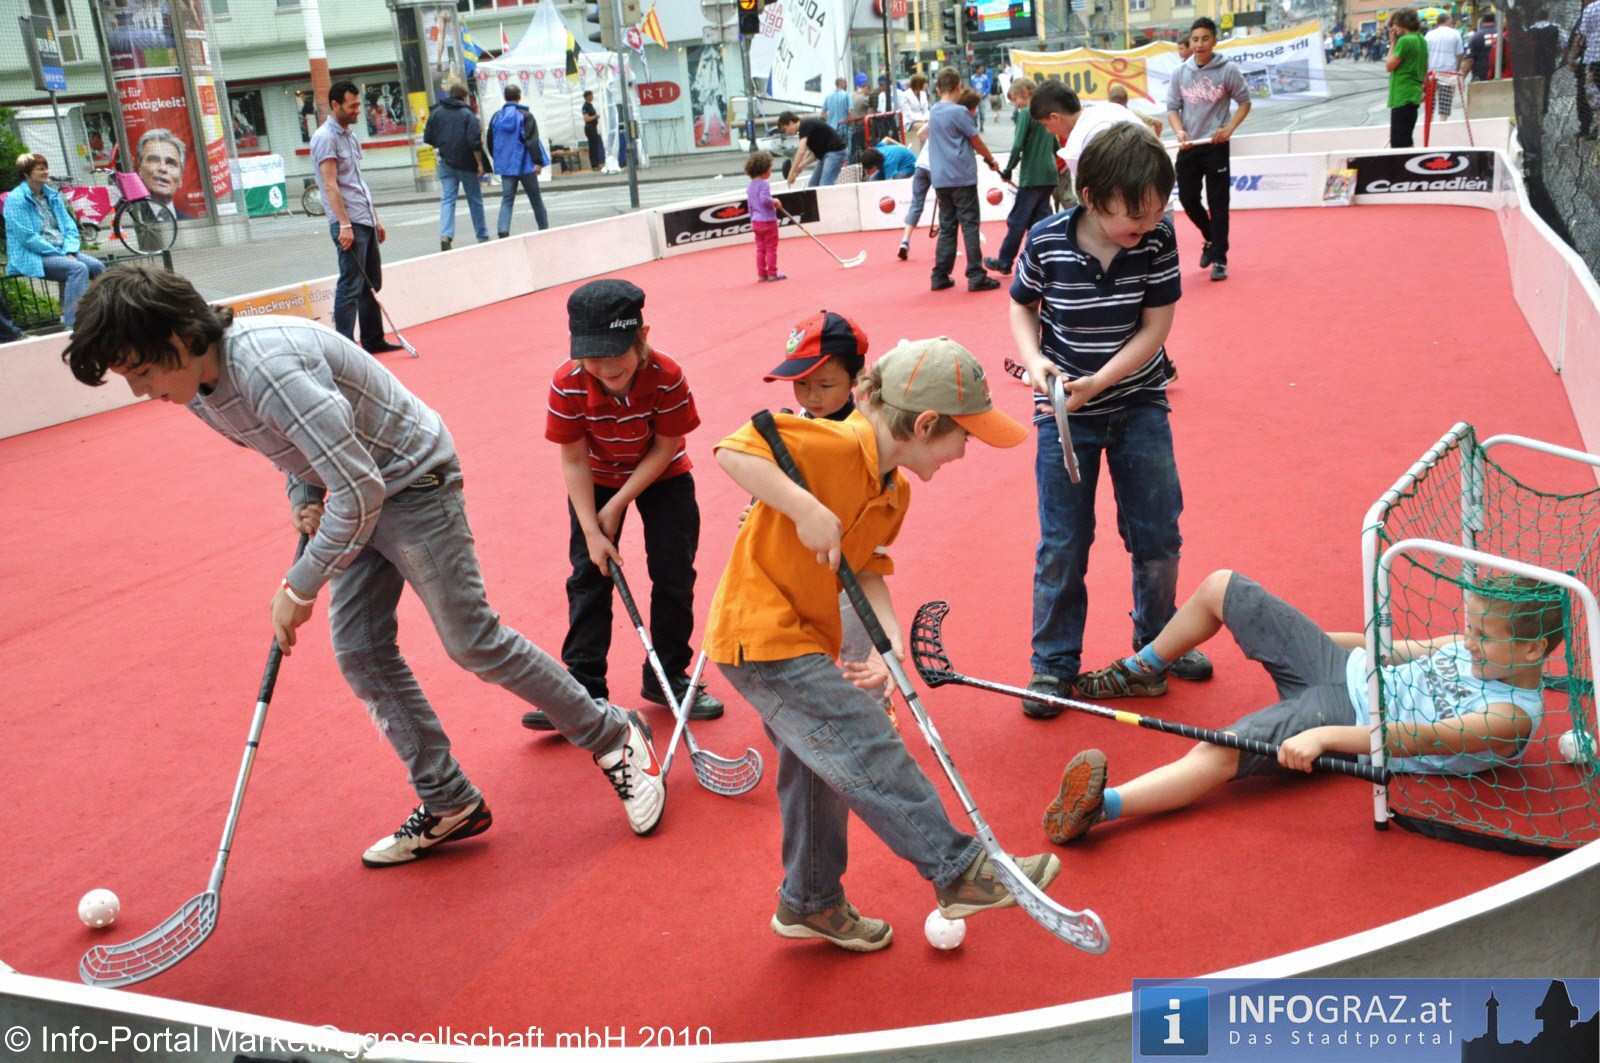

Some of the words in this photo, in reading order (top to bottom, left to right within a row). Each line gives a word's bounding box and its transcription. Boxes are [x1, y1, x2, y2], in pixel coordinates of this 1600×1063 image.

[120, 97, 186, 112] rechtigkeit!
[1366, 177, 1488, 193] Canadien
[676, 215, 801, 244] Canadn
